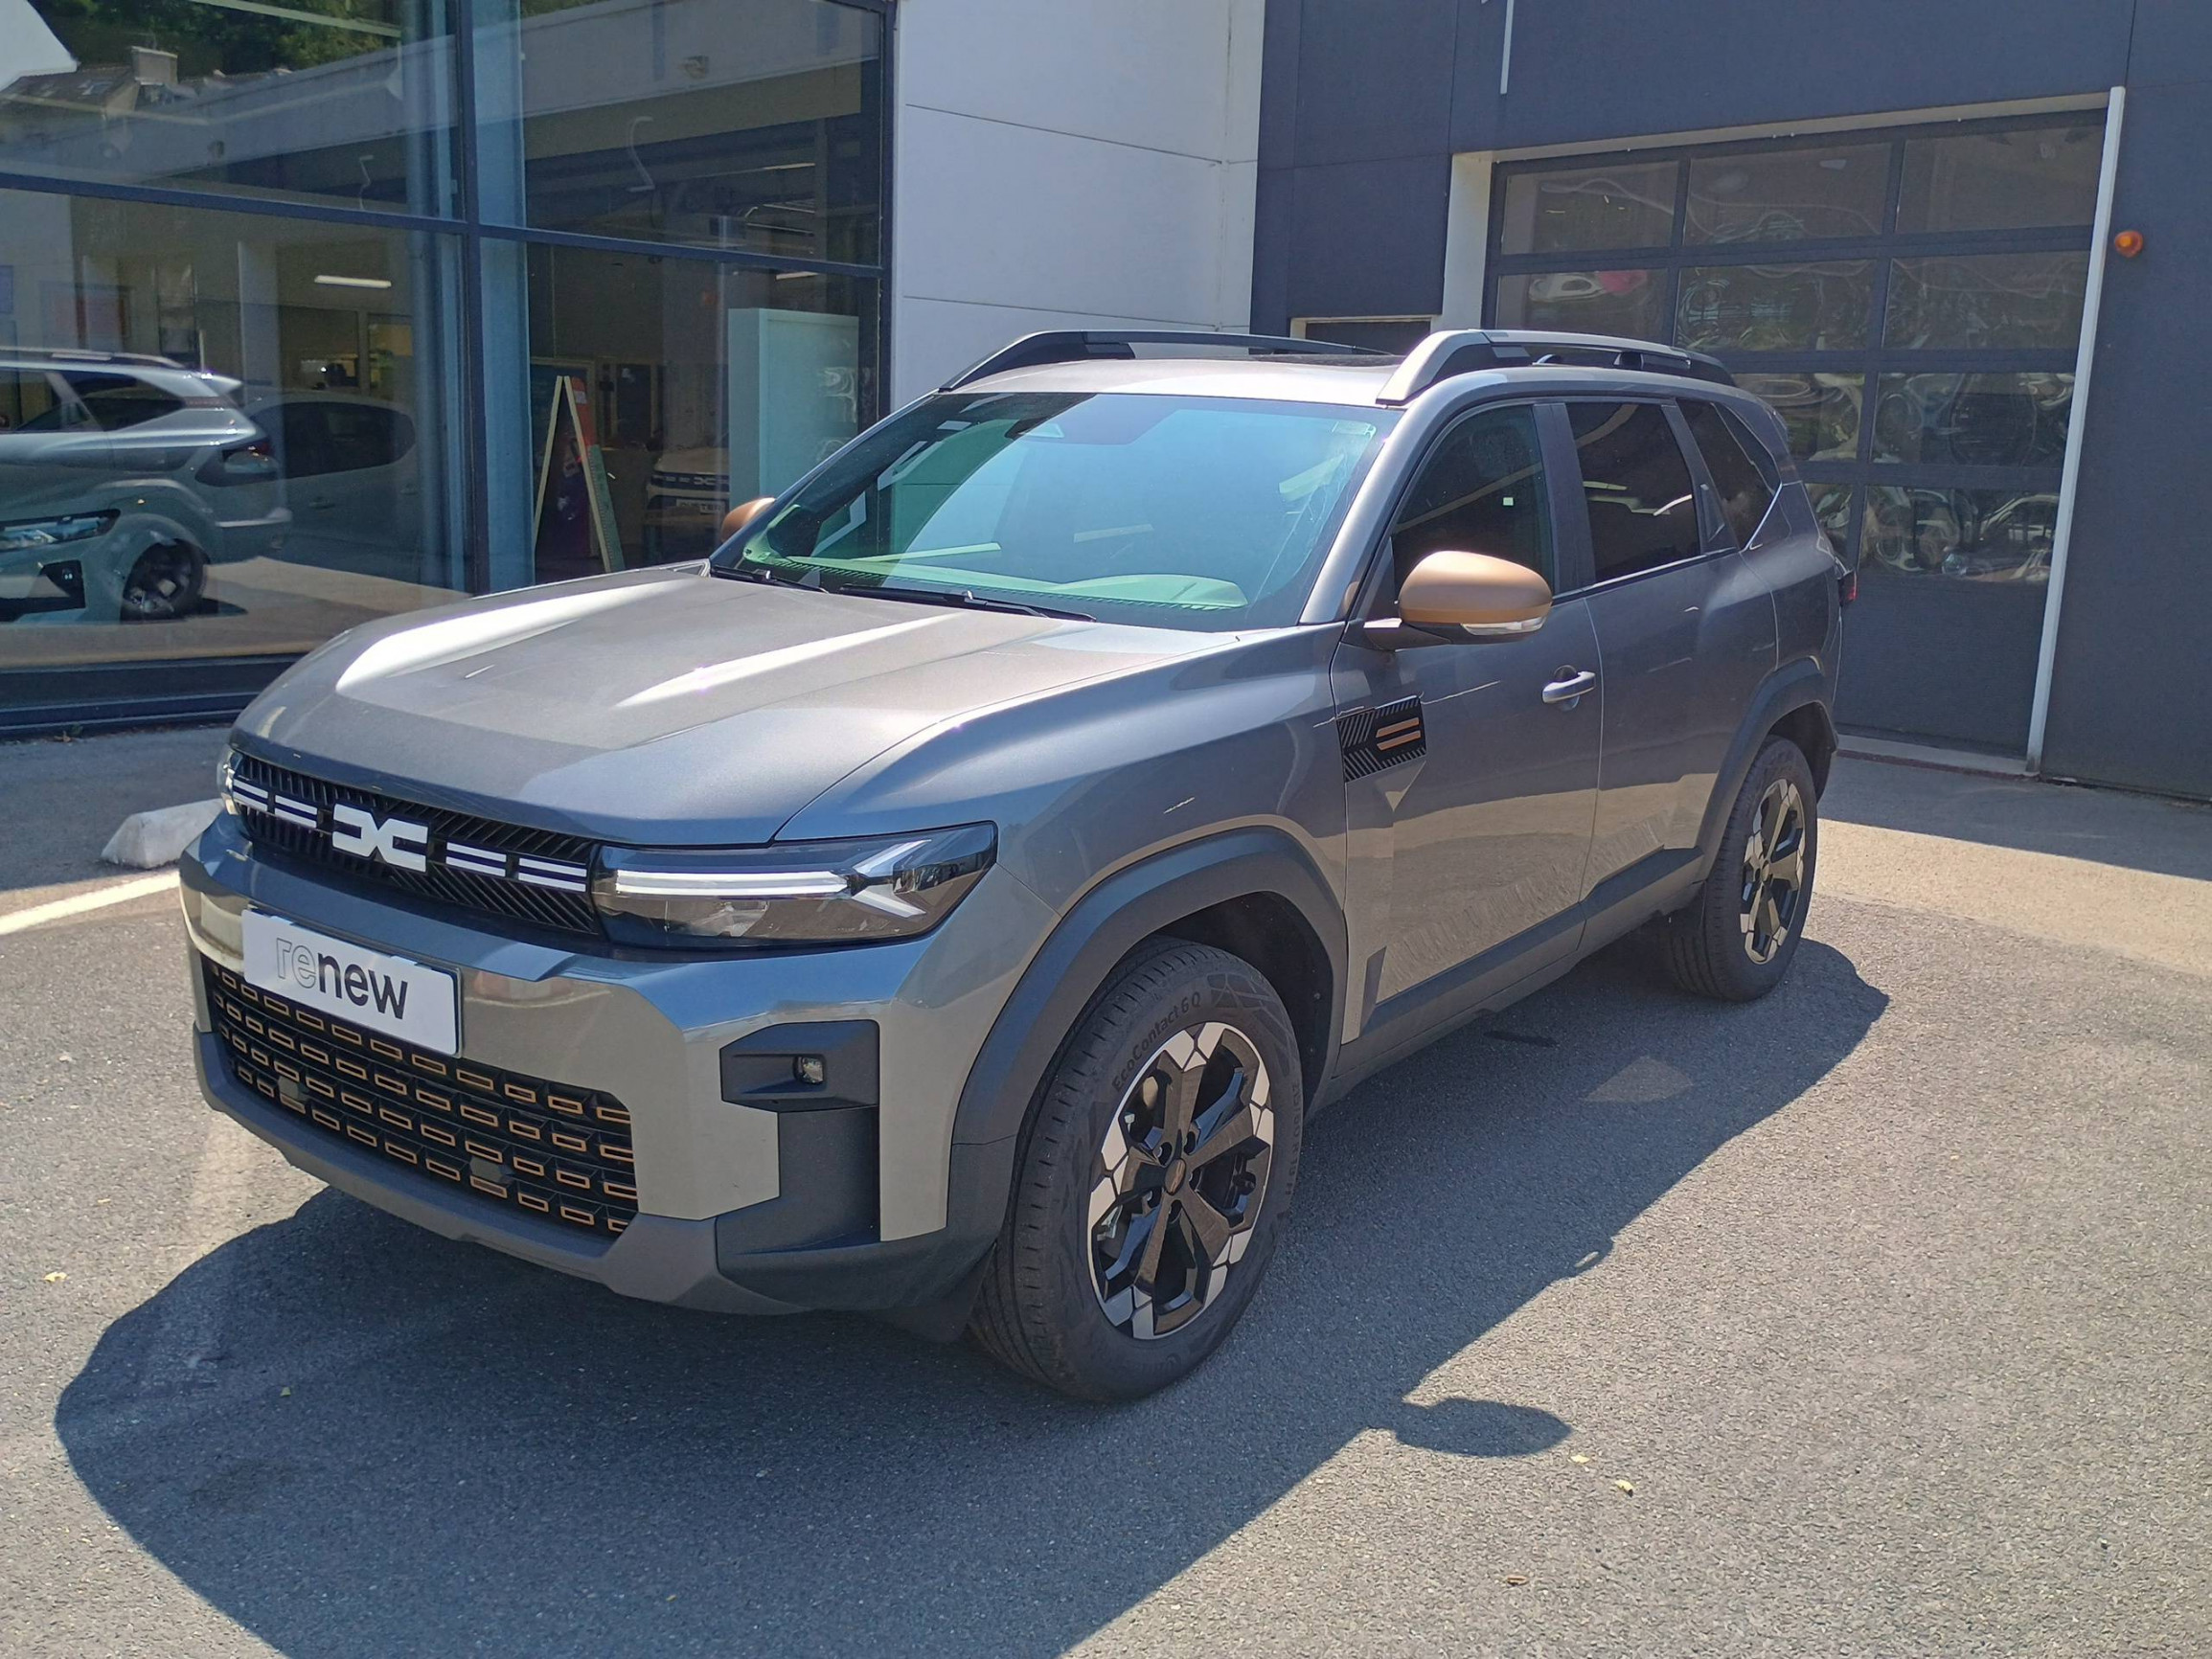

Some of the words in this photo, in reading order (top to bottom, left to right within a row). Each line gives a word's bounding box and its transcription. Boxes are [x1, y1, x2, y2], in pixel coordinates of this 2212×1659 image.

[276, 938, 408, 1020] renew
[1111, 1005, 1180, 1092] EcoContact
[1180, 995, 1190, 1013] 6
